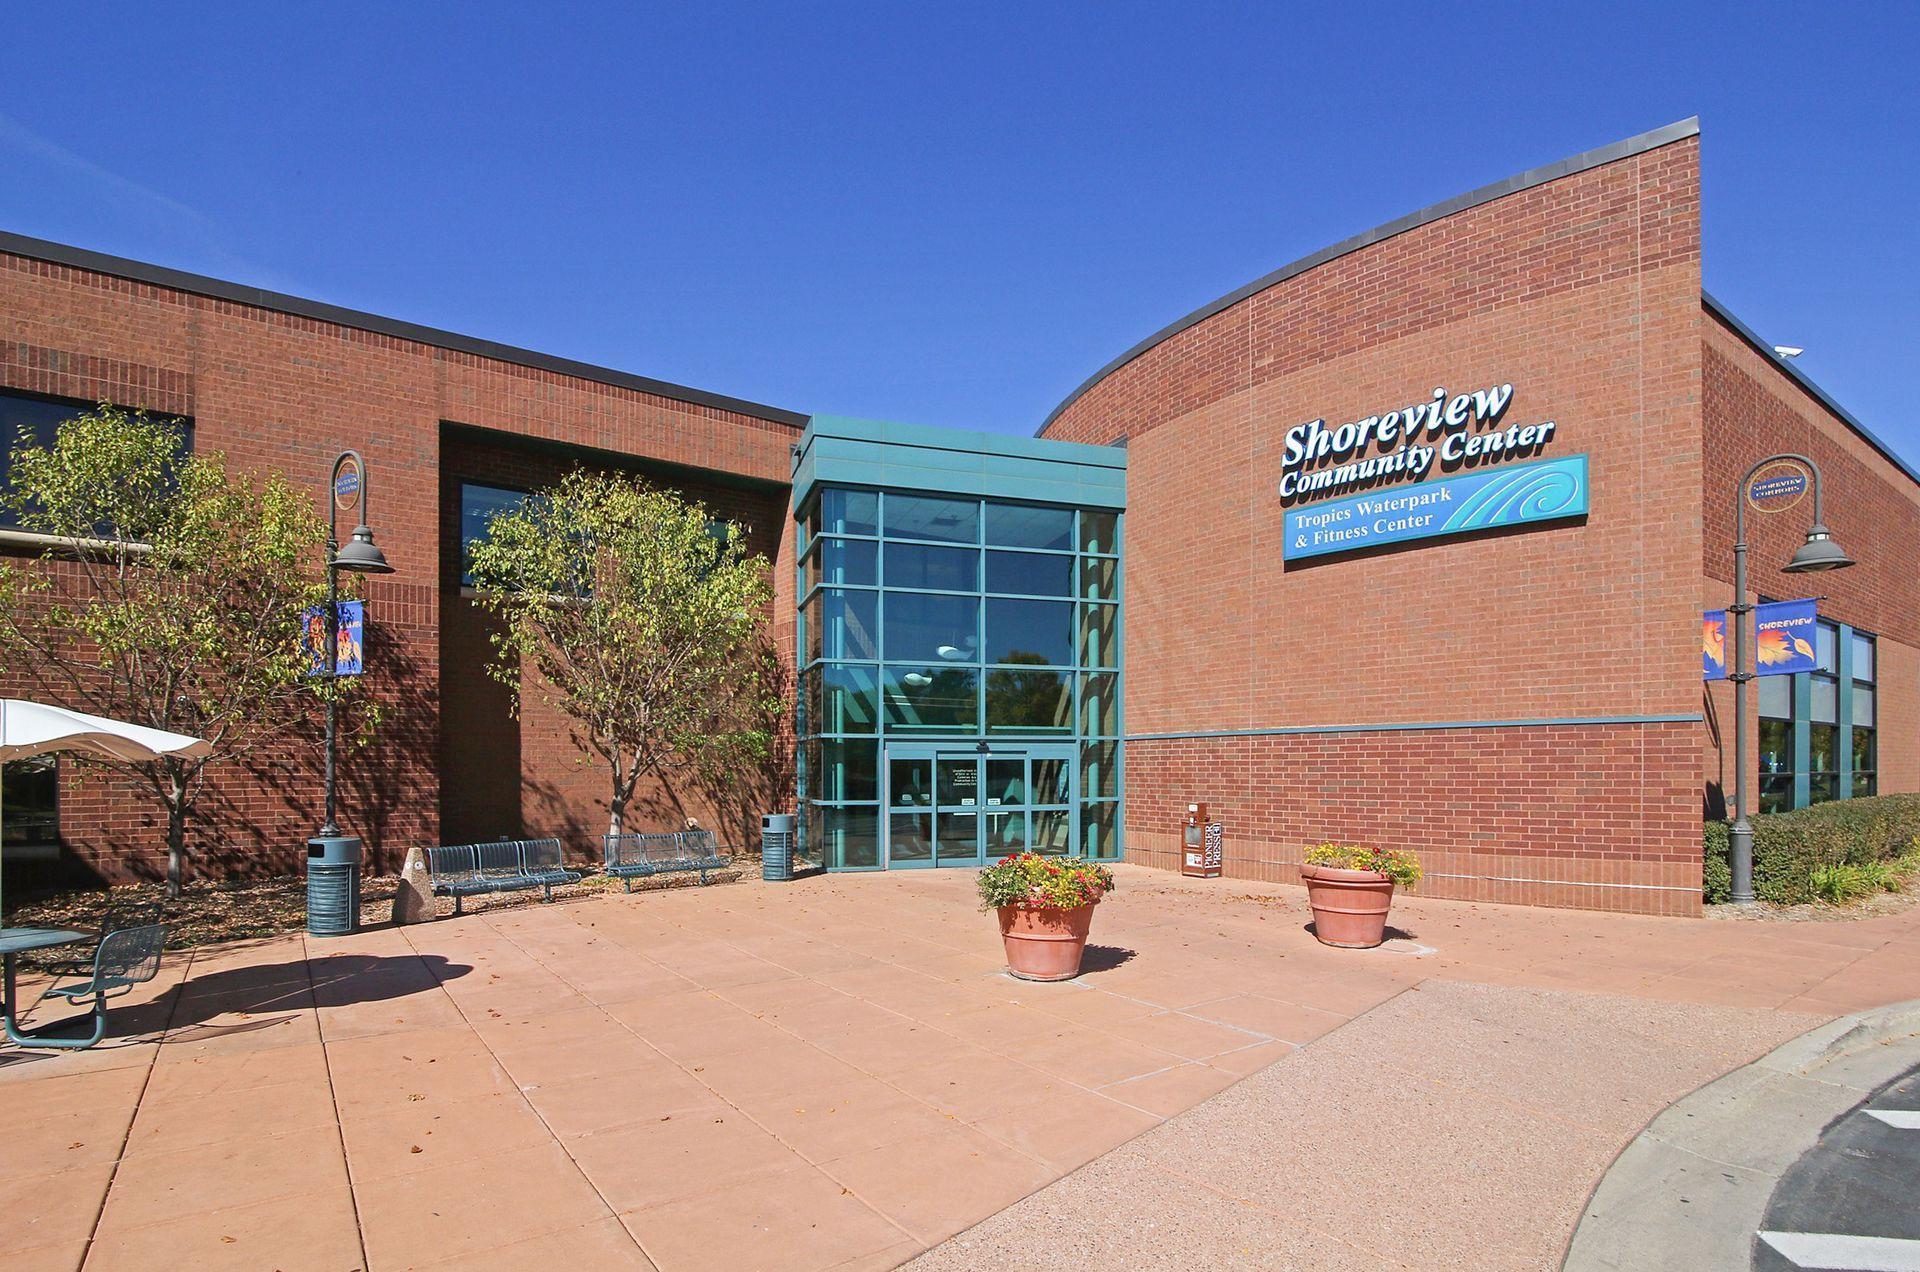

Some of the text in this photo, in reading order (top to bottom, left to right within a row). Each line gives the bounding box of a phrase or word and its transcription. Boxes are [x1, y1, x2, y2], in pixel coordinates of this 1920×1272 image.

[1281, 382, 1513, 468] Shoreview
[1279, 421, 1556, 497] Community Center
[1295, 487, 1452, 529] Tropics Waterpark
[1295, 514, 1433, 549] & Fitness Center
[1758, 617, 1813, 630] SHOREVIEW
[1204, 825, 1213, 868] PIONEER
[1213, 836, 1221, 867] PRESS
